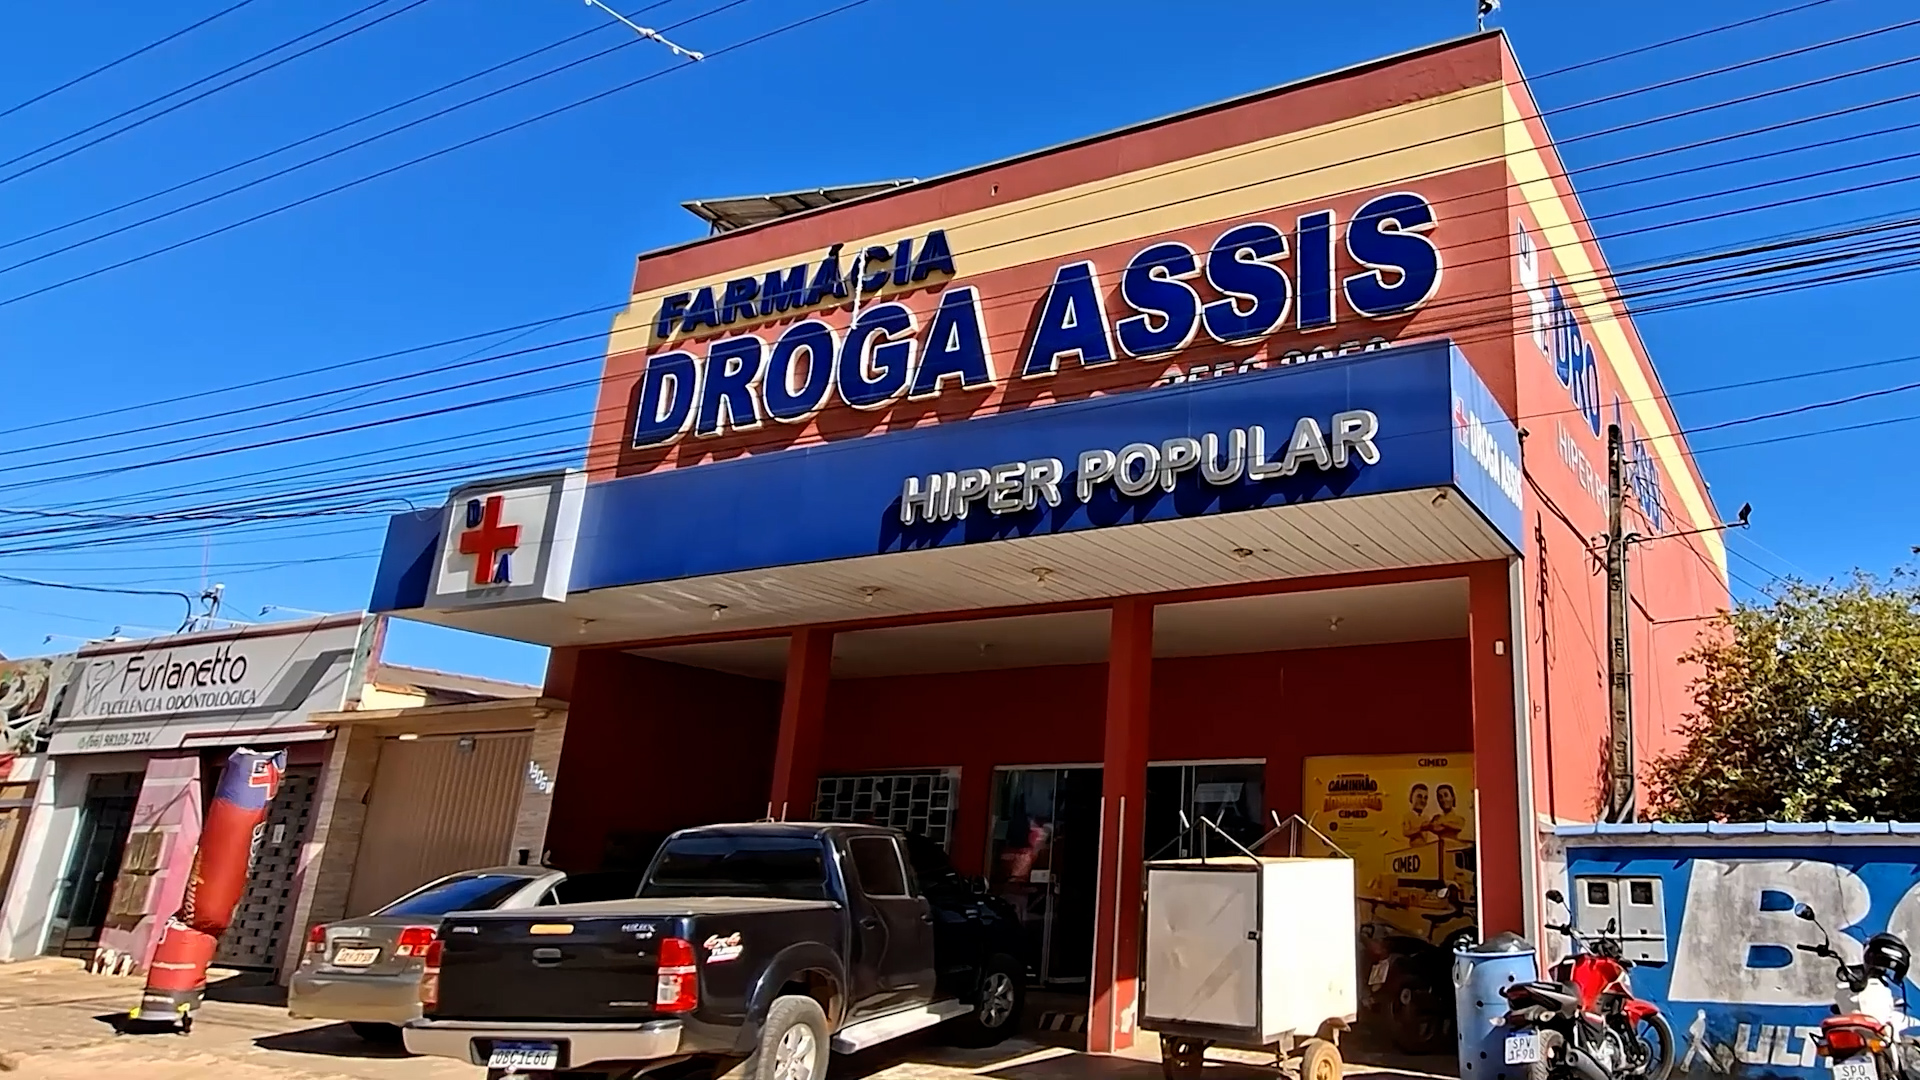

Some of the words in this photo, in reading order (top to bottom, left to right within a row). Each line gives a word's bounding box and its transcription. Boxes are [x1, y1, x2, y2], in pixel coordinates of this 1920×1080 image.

[657, 229, 957, 338] FARMÁCIA
[632, 286, 997, 449] DROGA
[1022, 191, 1443, 379] ASSIS
[900, 457, 1063, 525] HIPER
[1076, 410, 1380, 502] POPULAR
[1557, 420, 1595, 500] HIPER
[120, 646, 247, 693] Furlanetto
[1418, 758, 1448, 767] CIMED
[1338, 810, 1368, 818] CIMED
[1393, 855, 1421, 873] CIMED
[1507, 1049, 1535, 1062] 1F98
[1512, 1038, 1532, 1049] SPV
[1734, 1023, 1834, 1068] ULT
